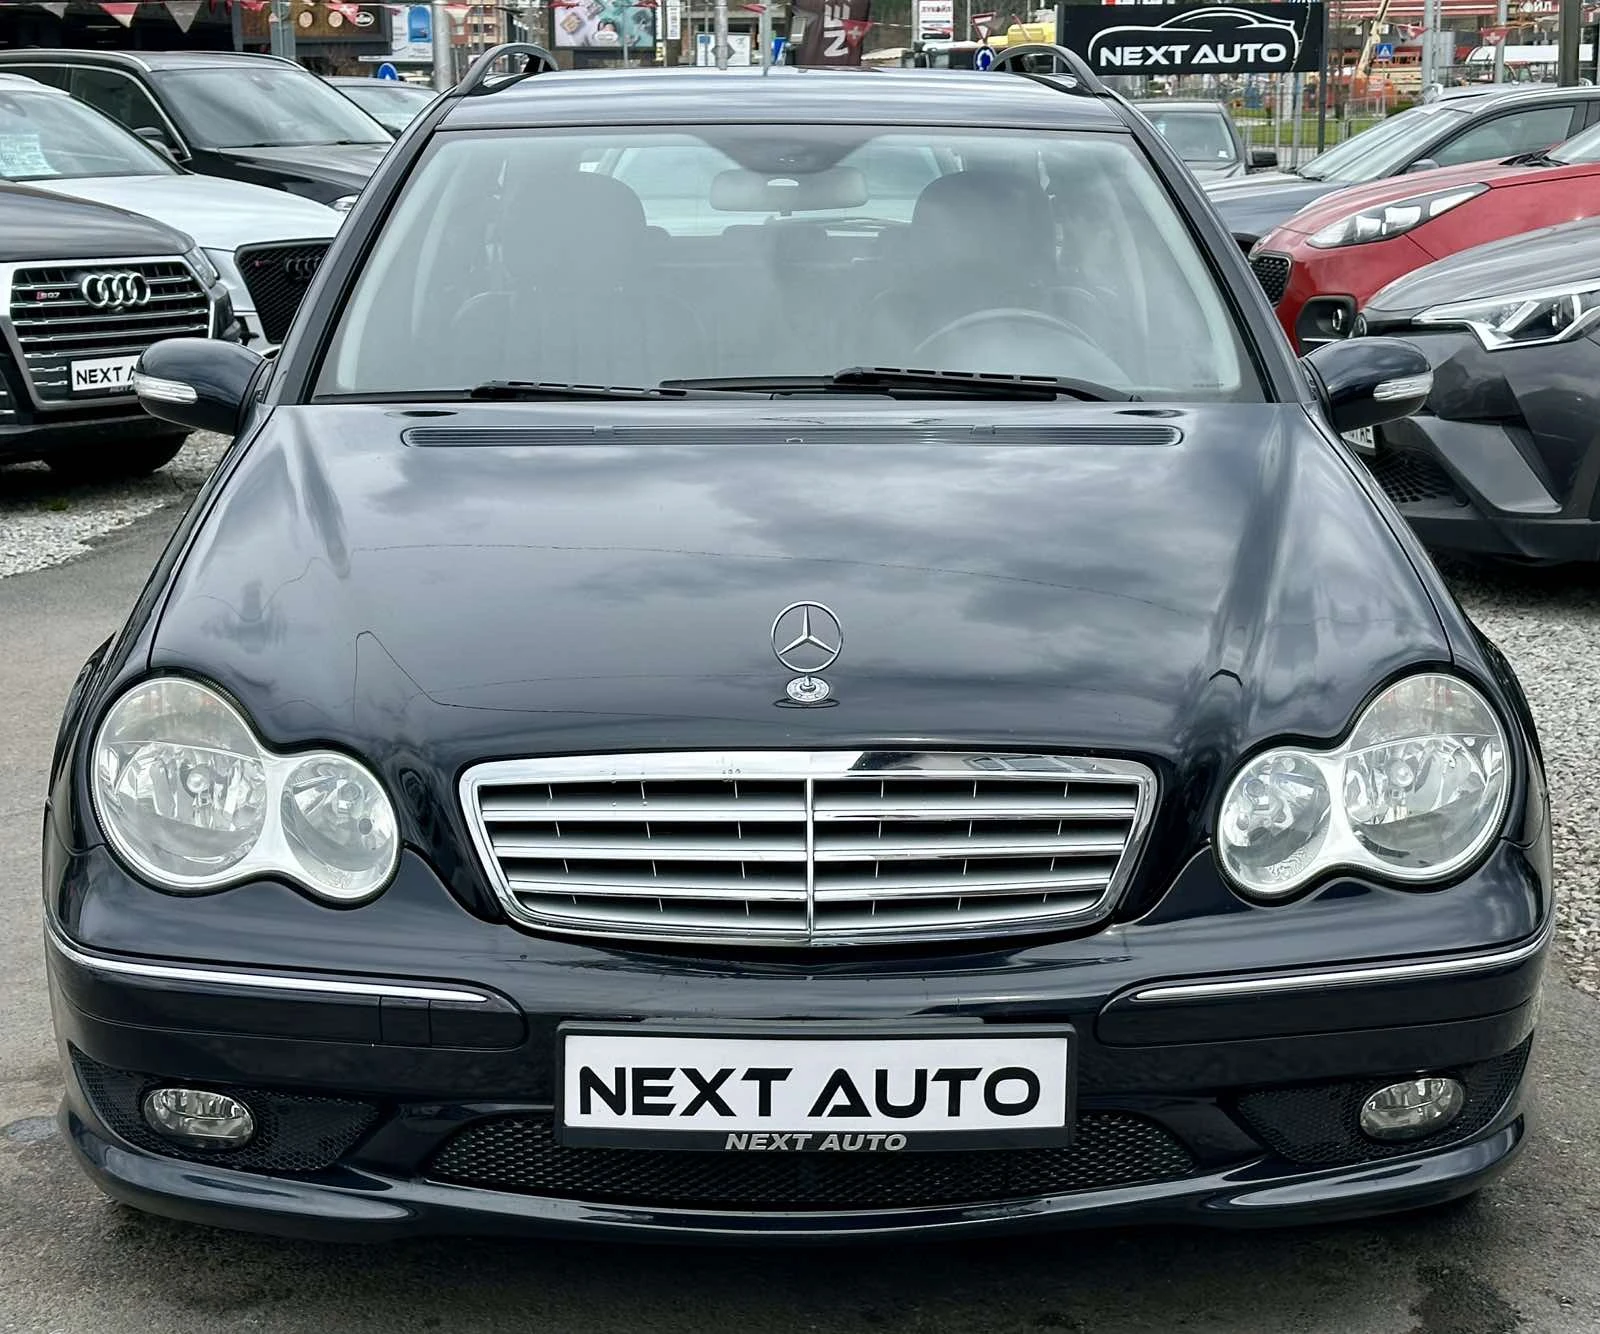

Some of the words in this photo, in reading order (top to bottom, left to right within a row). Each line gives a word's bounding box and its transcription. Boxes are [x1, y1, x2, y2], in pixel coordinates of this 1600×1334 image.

[1099, 45, 1190, 67] NEXT
[1191, 43, 1287, 65] AUTO
[76, 366, 123, 385] NEXT
[578, 1065, 793, 1117] NEXT
[807, 1066, 1041, 1119] AUTO
[724, 1133, 812, 1151] NEXT
[818, 1133, 908, 1152] AUTO
